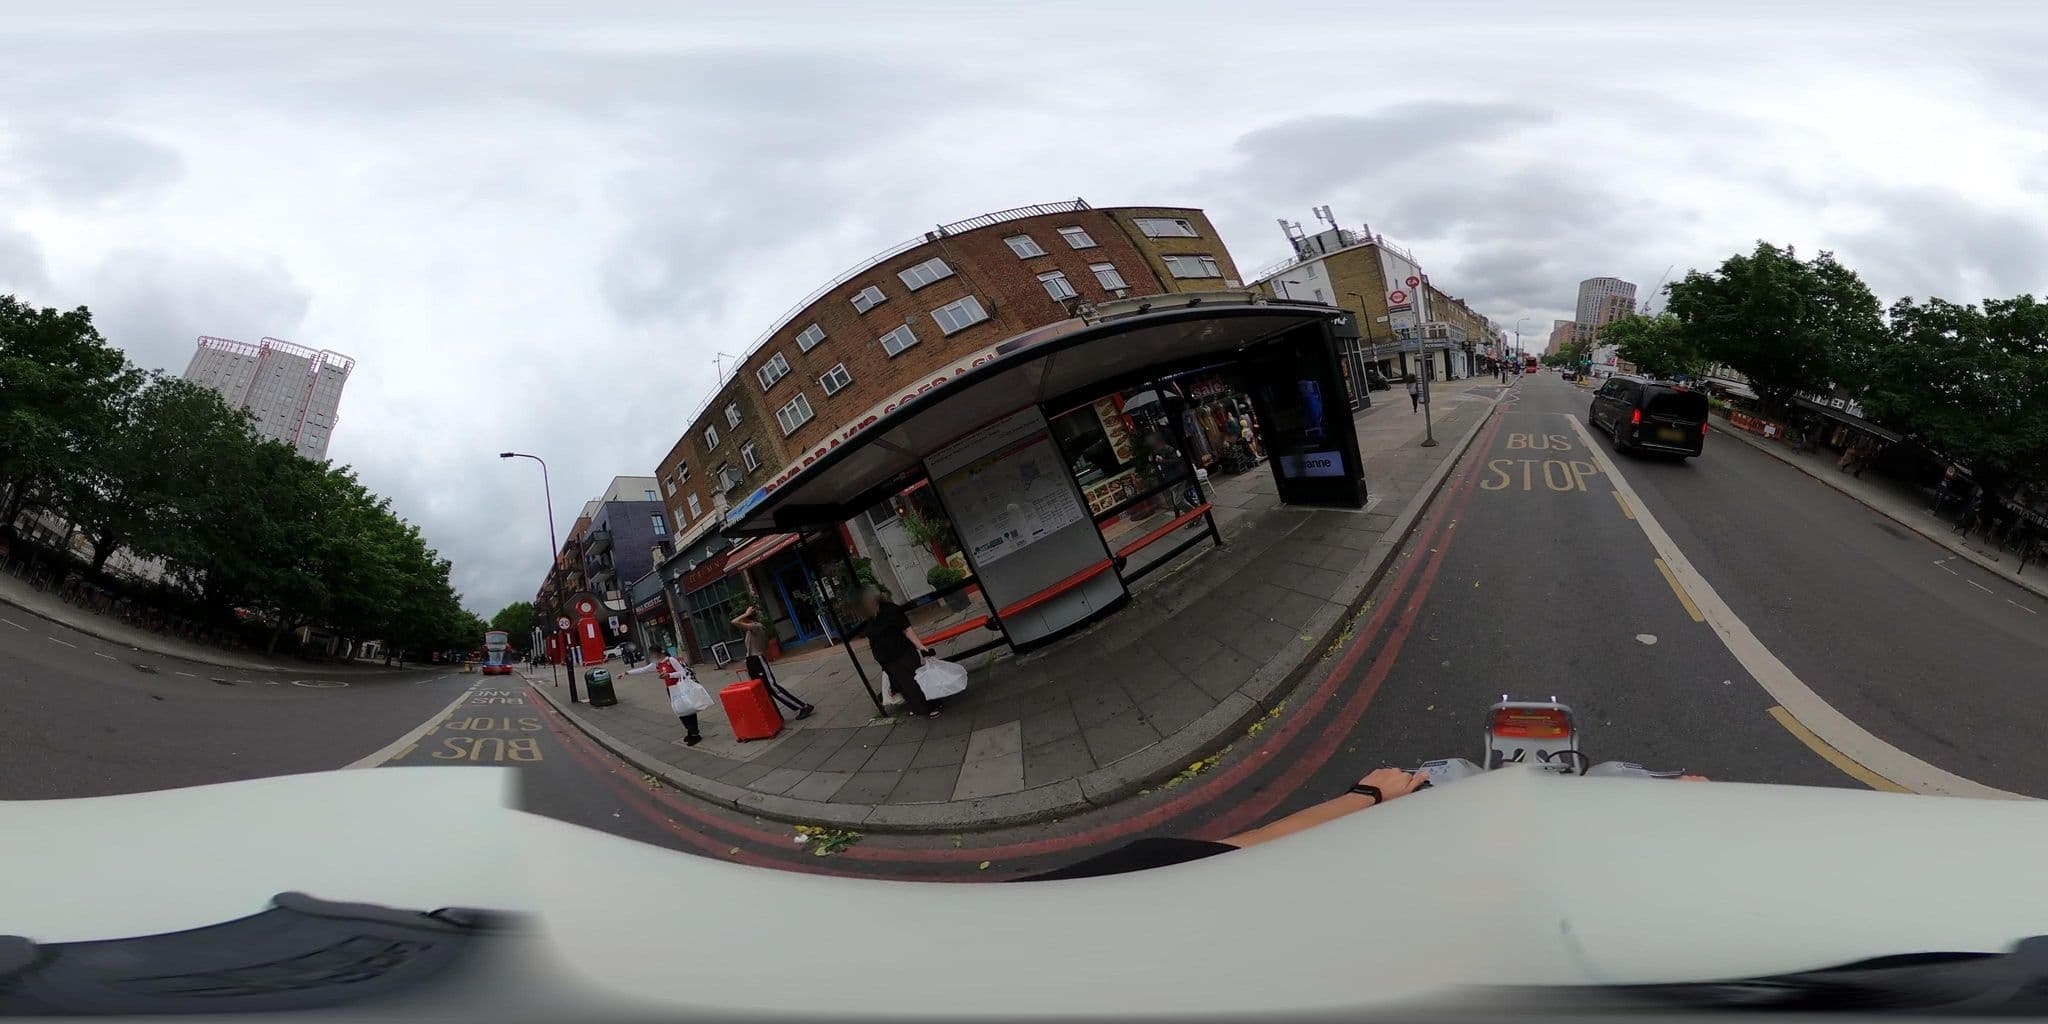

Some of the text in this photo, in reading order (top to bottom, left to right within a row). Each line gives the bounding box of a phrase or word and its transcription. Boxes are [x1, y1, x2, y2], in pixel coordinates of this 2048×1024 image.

[1506, 433, 1572, 451] BUS
[1481, 459, 1598, 491] STOP
[446, 717, 543, 731] STOP
[432, 737, 544, 761] BUS
